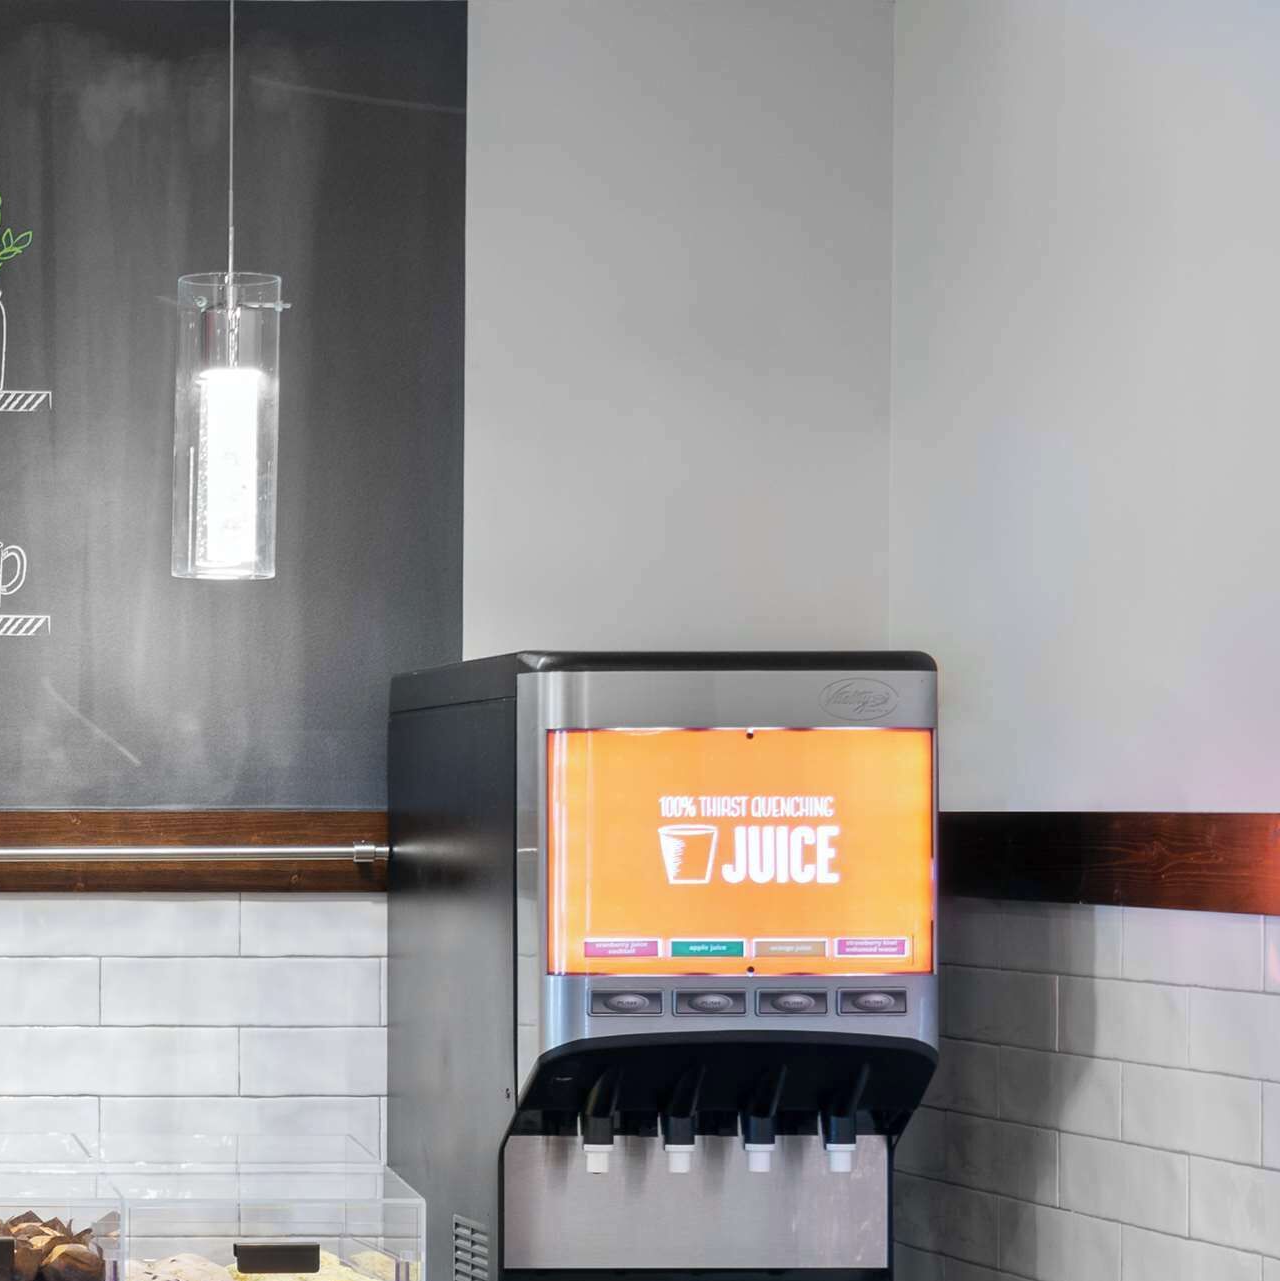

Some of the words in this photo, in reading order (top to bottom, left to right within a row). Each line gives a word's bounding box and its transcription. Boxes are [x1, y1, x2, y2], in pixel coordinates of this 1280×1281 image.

[658, 796, 697, 819] 100%
[698, 796, 749, 818] THIRST
[750, 796, 836, 819] QUENCHING
[721, 824, 841, 885] JUICE
